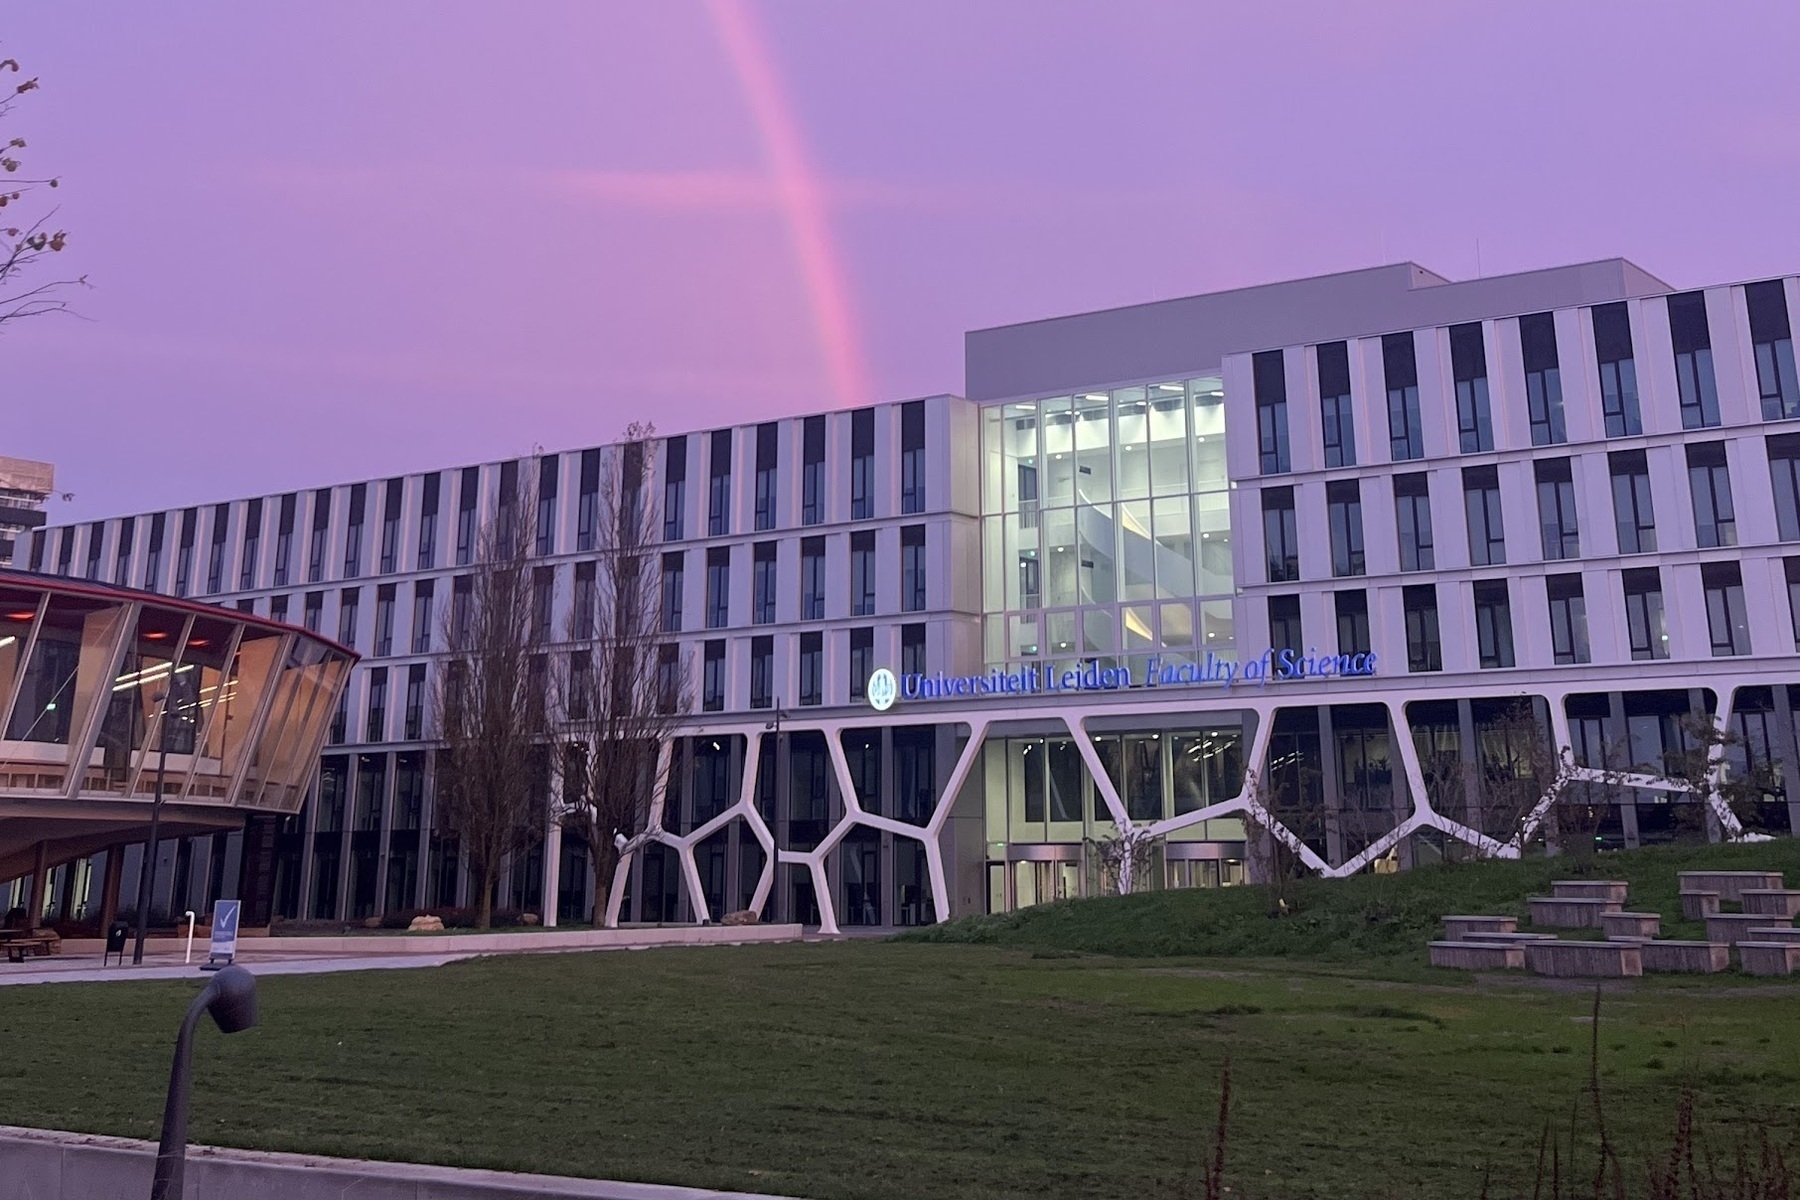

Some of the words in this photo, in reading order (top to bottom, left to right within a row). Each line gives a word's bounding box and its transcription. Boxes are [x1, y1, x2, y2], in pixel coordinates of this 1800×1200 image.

[1046, 658, 1131, 691] Leiden
[1147, 651, 1238, 690] Faculty
[1245, 648, 1274, 688] of
[1277, 647, 1377, 679] Science
